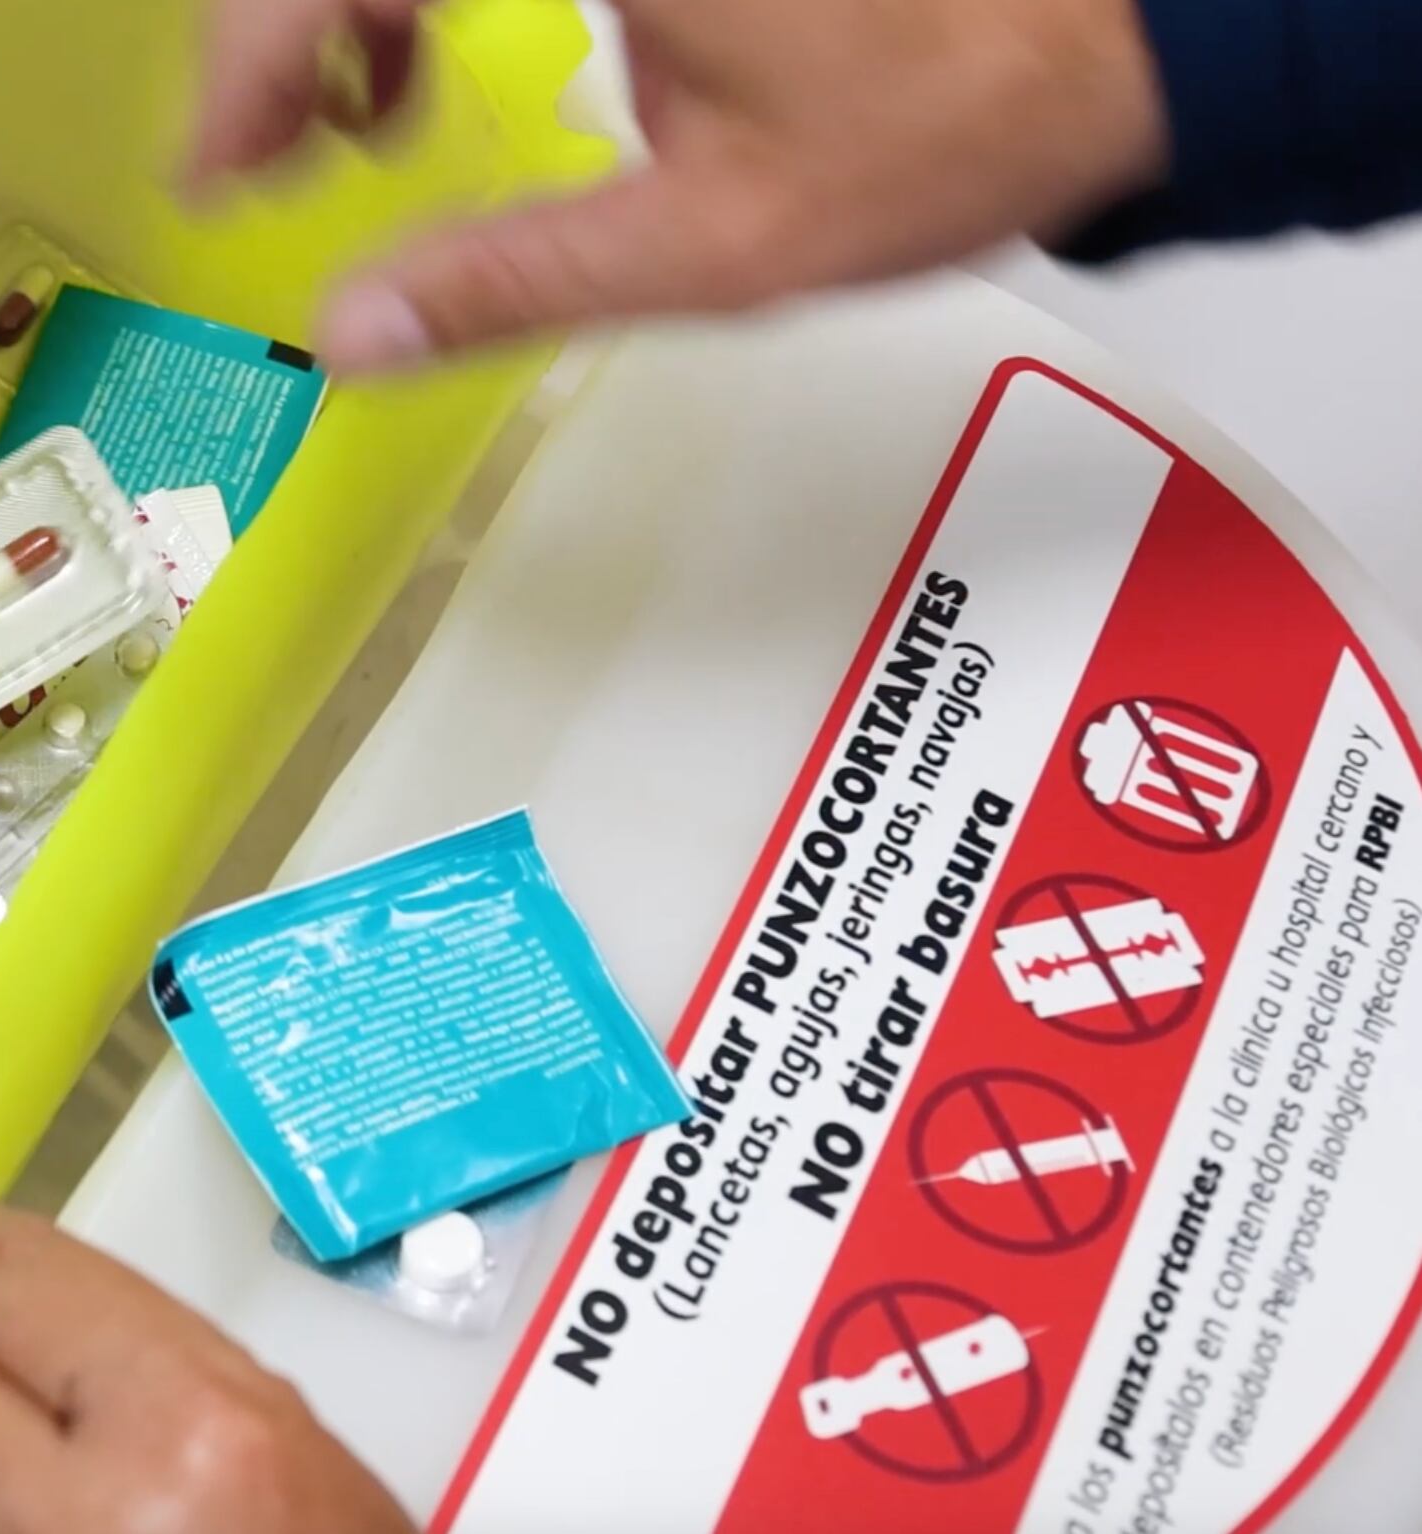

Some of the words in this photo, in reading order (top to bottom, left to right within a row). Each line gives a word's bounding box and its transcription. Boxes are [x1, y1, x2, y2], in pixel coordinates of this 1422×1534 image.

[1353, 722, 1384, 750] y
[1315, 744, 1370, 854] cercano
[1354, 792, 1405, 873] RPBI
[1268, 852, 1333, 969] hospital
[1338, 873, 1380, 948] para
[552, 1289, 629, 1387] NO
[612, 1015, 758, 1280] depositar
[731, 570, 969, 1016] PUNZOCORTANTES
[653, 1113, 792, 1321] (Lancetas,
[769, 965, 860, 1098] agujas,
[826, 801, 933, 965] jeringas,
[909, 641, 995, 791] navajas)
[787, 1120, 865, 1221] NO
[838, 975, 929, 1114] tirar
[897, 788, 1015, 976] basura
[1266, 969, 1294, 993] u
[1287, 944, 1356, 1094] especiales
[1230, 993, 1283, 1089] clínica
[1209, 1128, 1237, 1153] a
[1212, 1089, 1250, 1126] la
[1207, 1326, 1284, 1470] (Residuos
[1260, 1184, 1331, 1324] Peligrosos
[1308, 1045, 1378, 1182] Biológicos
[1353, 897, 1422, 1044] Infecciosos)
[1213, 1095, 1306, 1312] contenedores
[1097, 1157, 1224, 1462] punzocortantes
[1195, 1317, 1229, 1362] en
[1067, 1461, 1115, 1515] los
